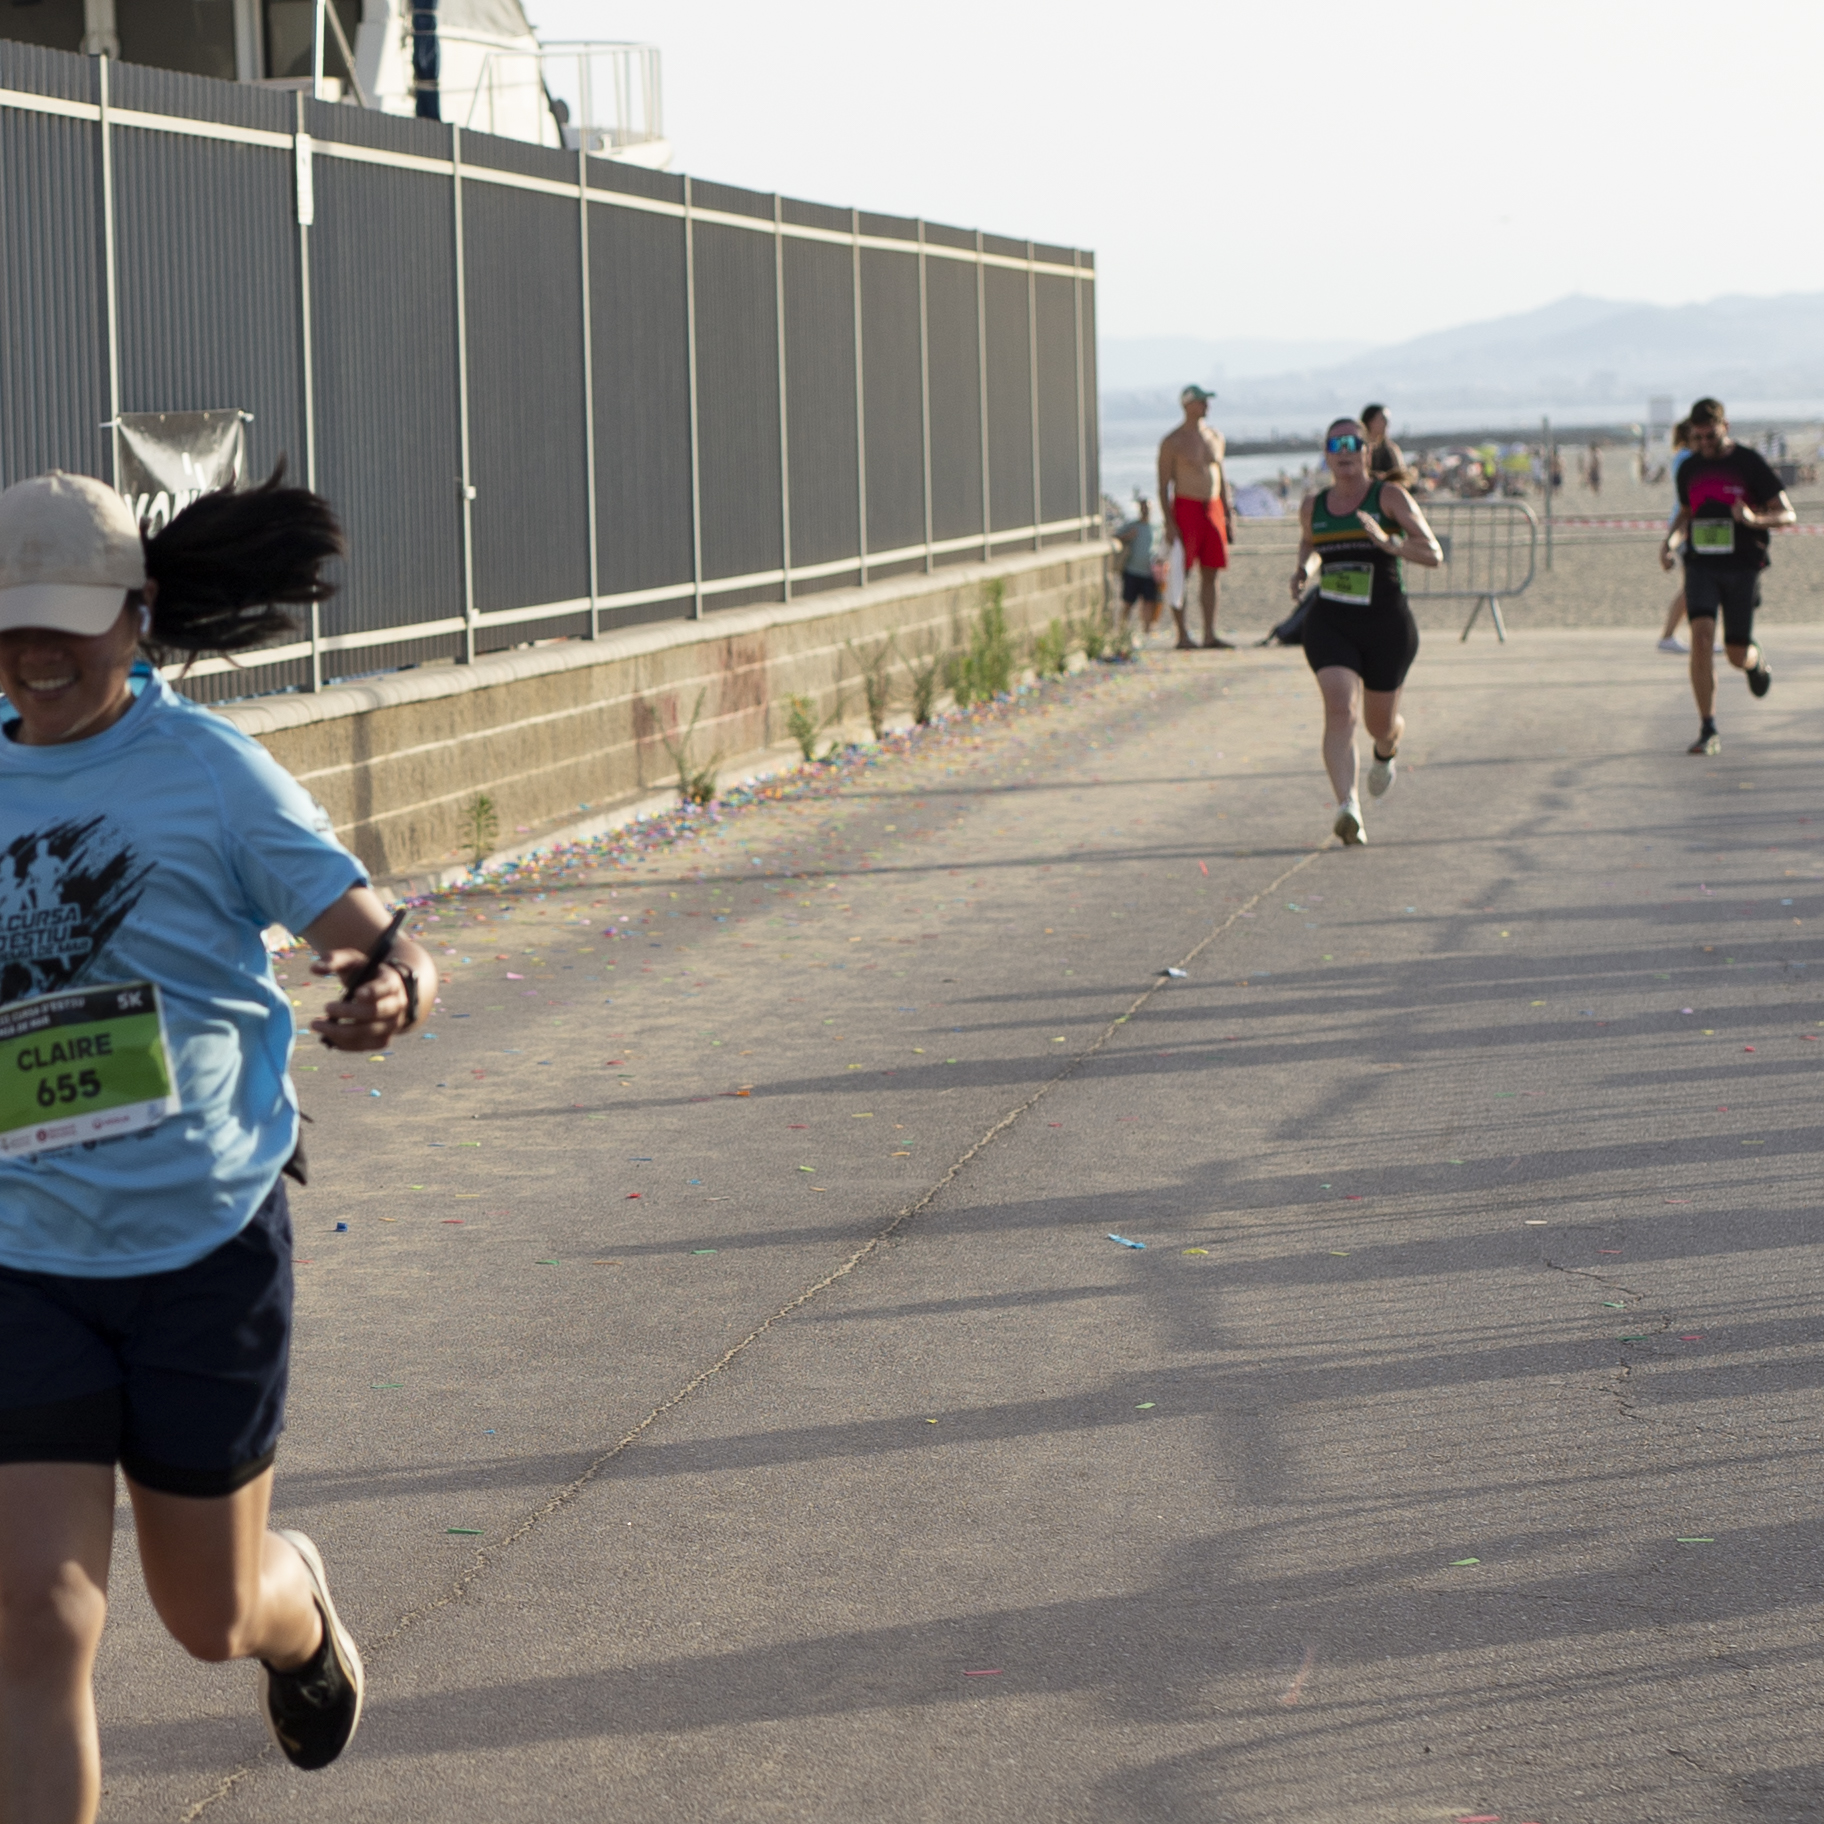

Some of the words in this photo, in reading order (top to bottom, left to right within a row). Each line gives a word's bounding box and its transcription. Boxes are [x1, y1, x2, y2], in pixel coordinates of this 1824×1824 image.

[7, 907, 79, 931] CURSA
[116, 991, 144, 1011] 5K
[17, 1033, 113, 1072] CLAIRE
[37, 1069, 102, 1108] 655
